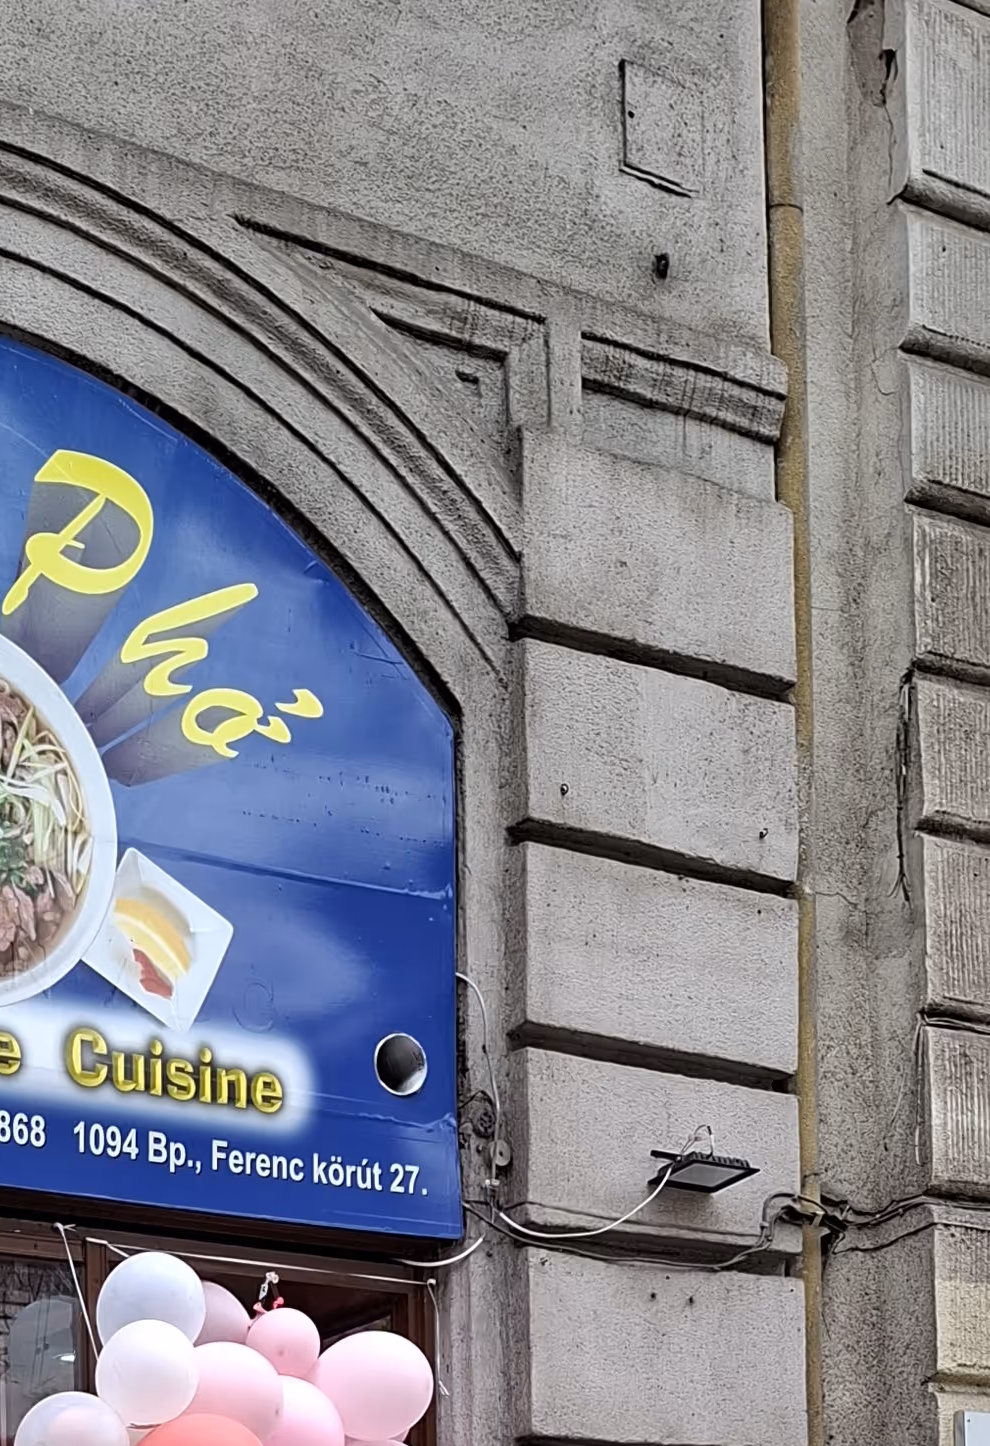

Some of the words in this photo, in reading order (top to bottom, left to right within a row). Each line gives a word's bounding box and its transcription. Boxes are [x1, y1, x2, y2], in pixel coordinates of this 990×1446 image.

[66, 1028, 283, 1113] Cuisine
[73, 1121, 139, 1160] 1094
[148, 1131, 201, 1174] Bp.,
[212, 1139, 305, 1182] Ferenc
[313, 1153, 383, 1192] körút
[390, 1163, 428, 1196] 27.
